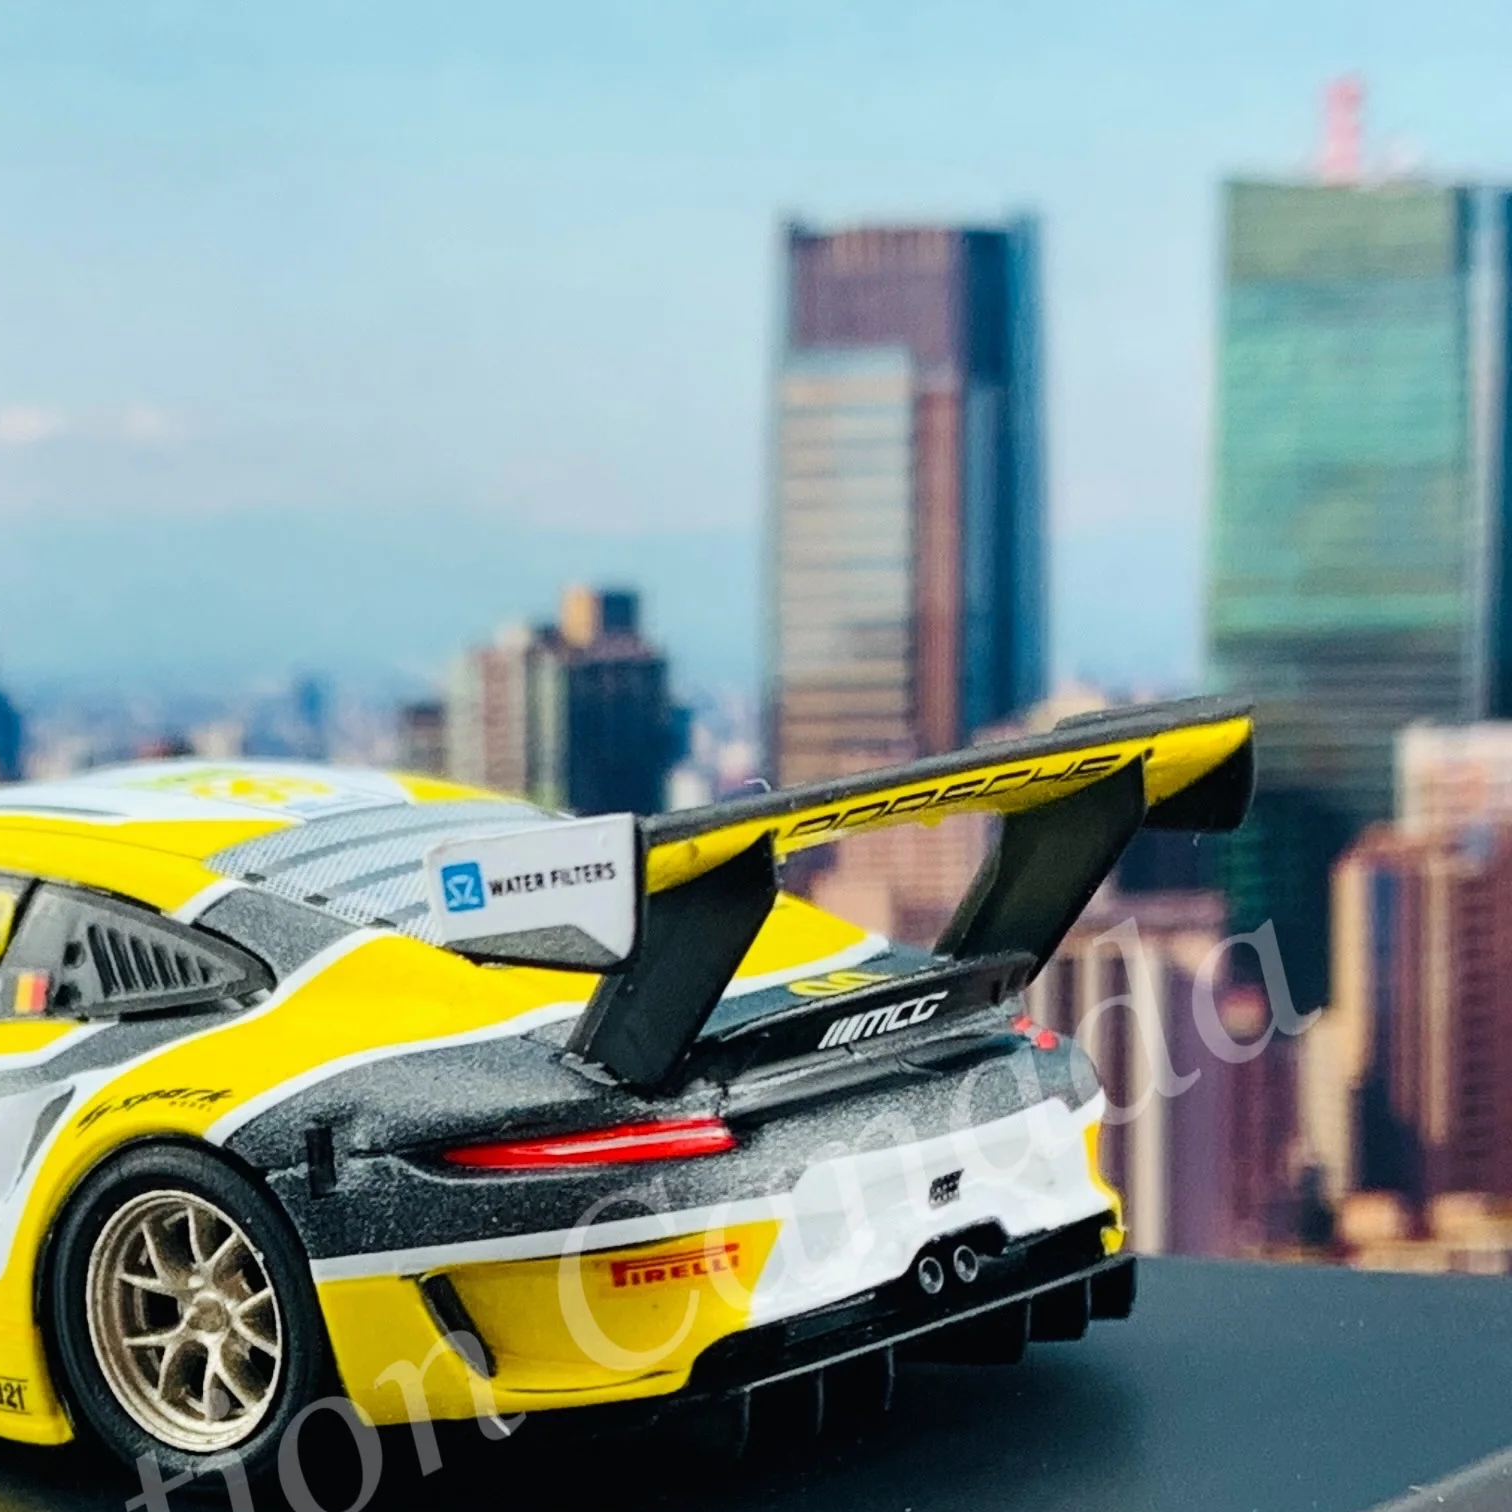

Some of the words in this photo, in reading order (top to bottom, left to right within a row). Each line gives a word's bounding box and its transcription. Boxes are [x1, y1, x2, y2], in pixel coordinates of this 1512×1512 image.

[489, 873, 546, 897] WATER
[551, 862, 617, 888] FILTERS
[611, 1243, 740, 1288] PIRELLI
